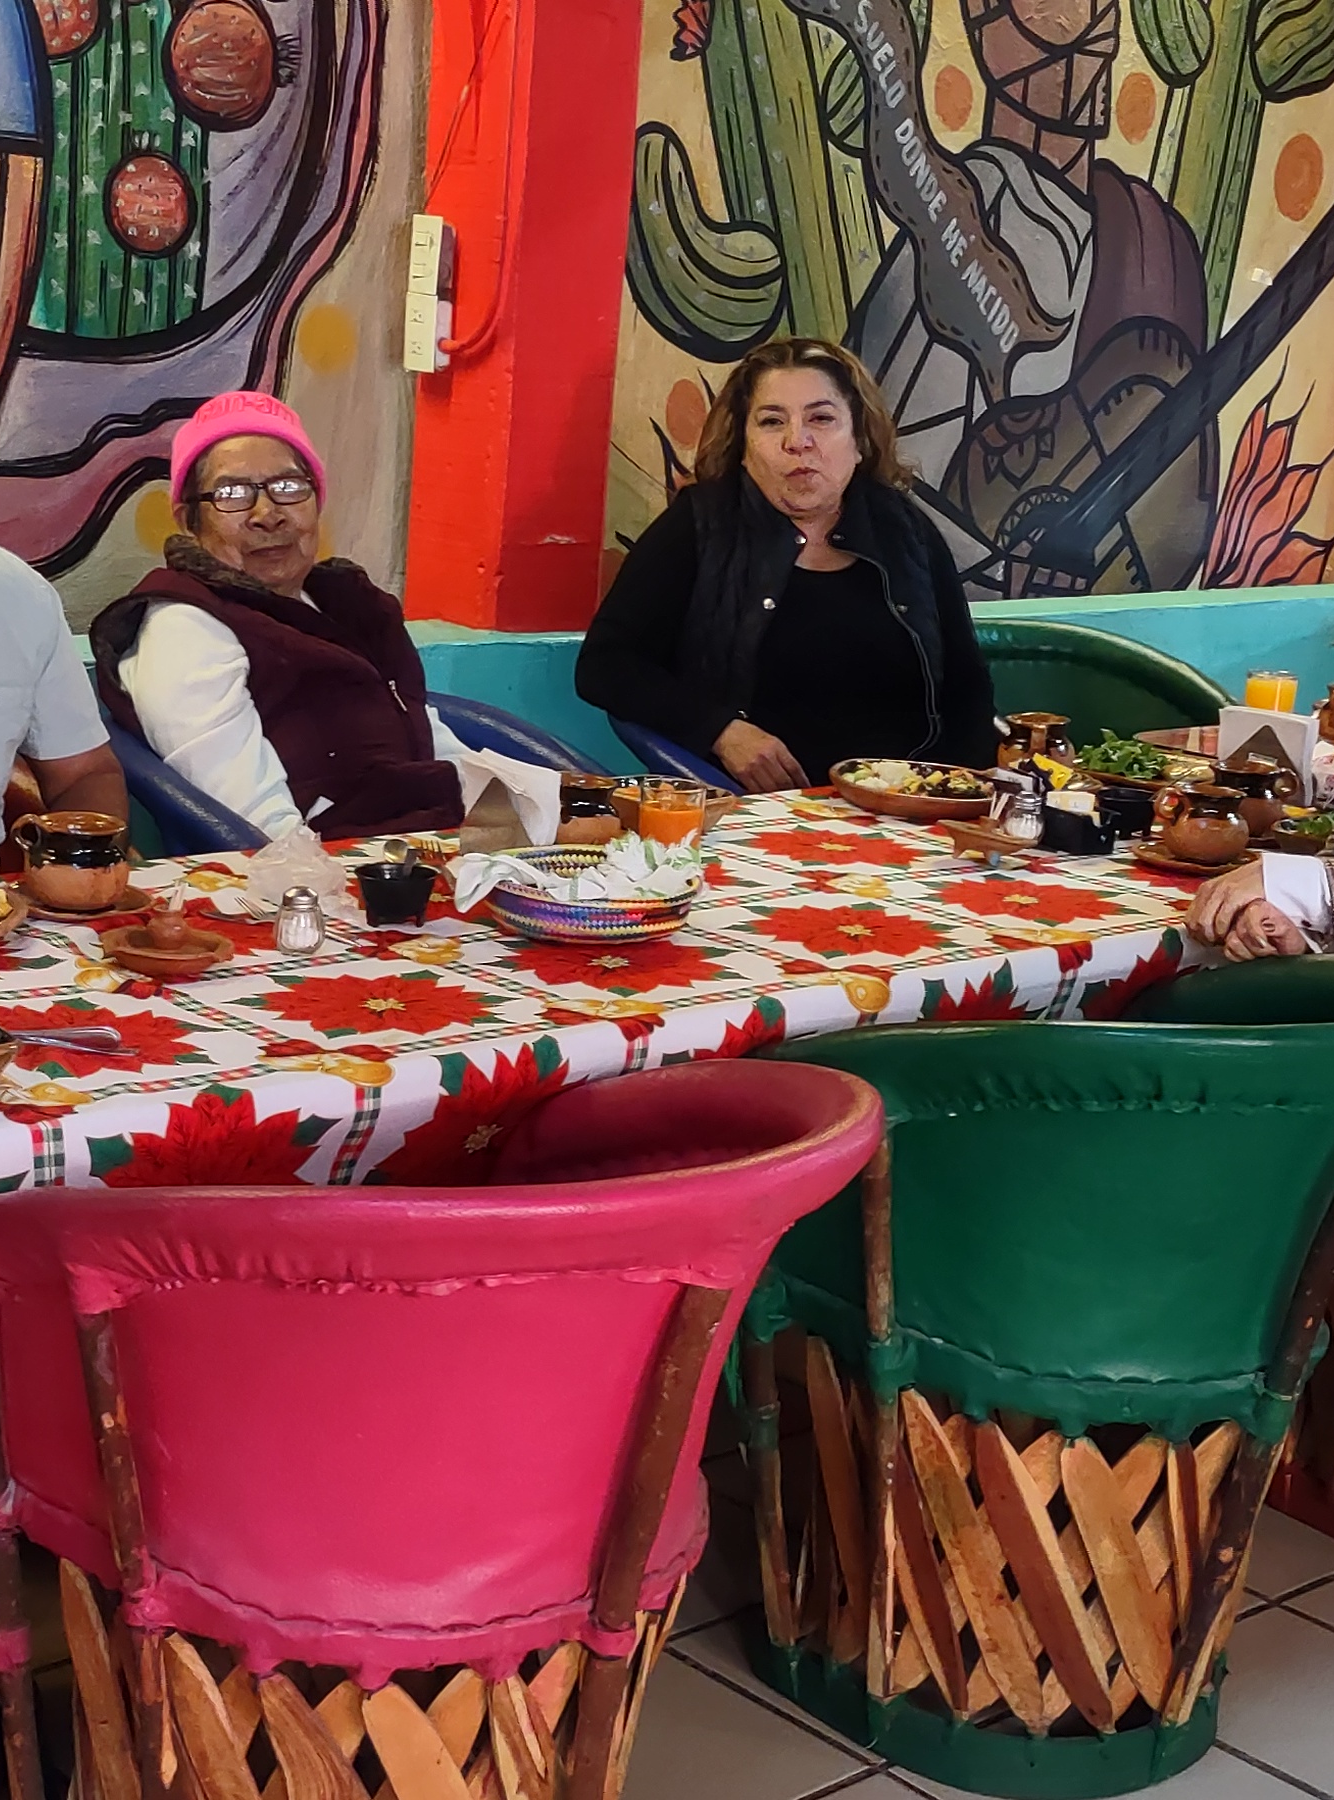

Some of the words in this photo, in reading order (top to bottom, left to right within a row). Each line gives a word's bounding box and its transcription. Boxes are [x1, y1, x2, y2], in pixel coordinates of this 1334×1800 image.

[854, 0, 906, 108] SUELO
[896, 118, 947, 223] DONDE
[961, 263, 1019, 353] NACIDO
